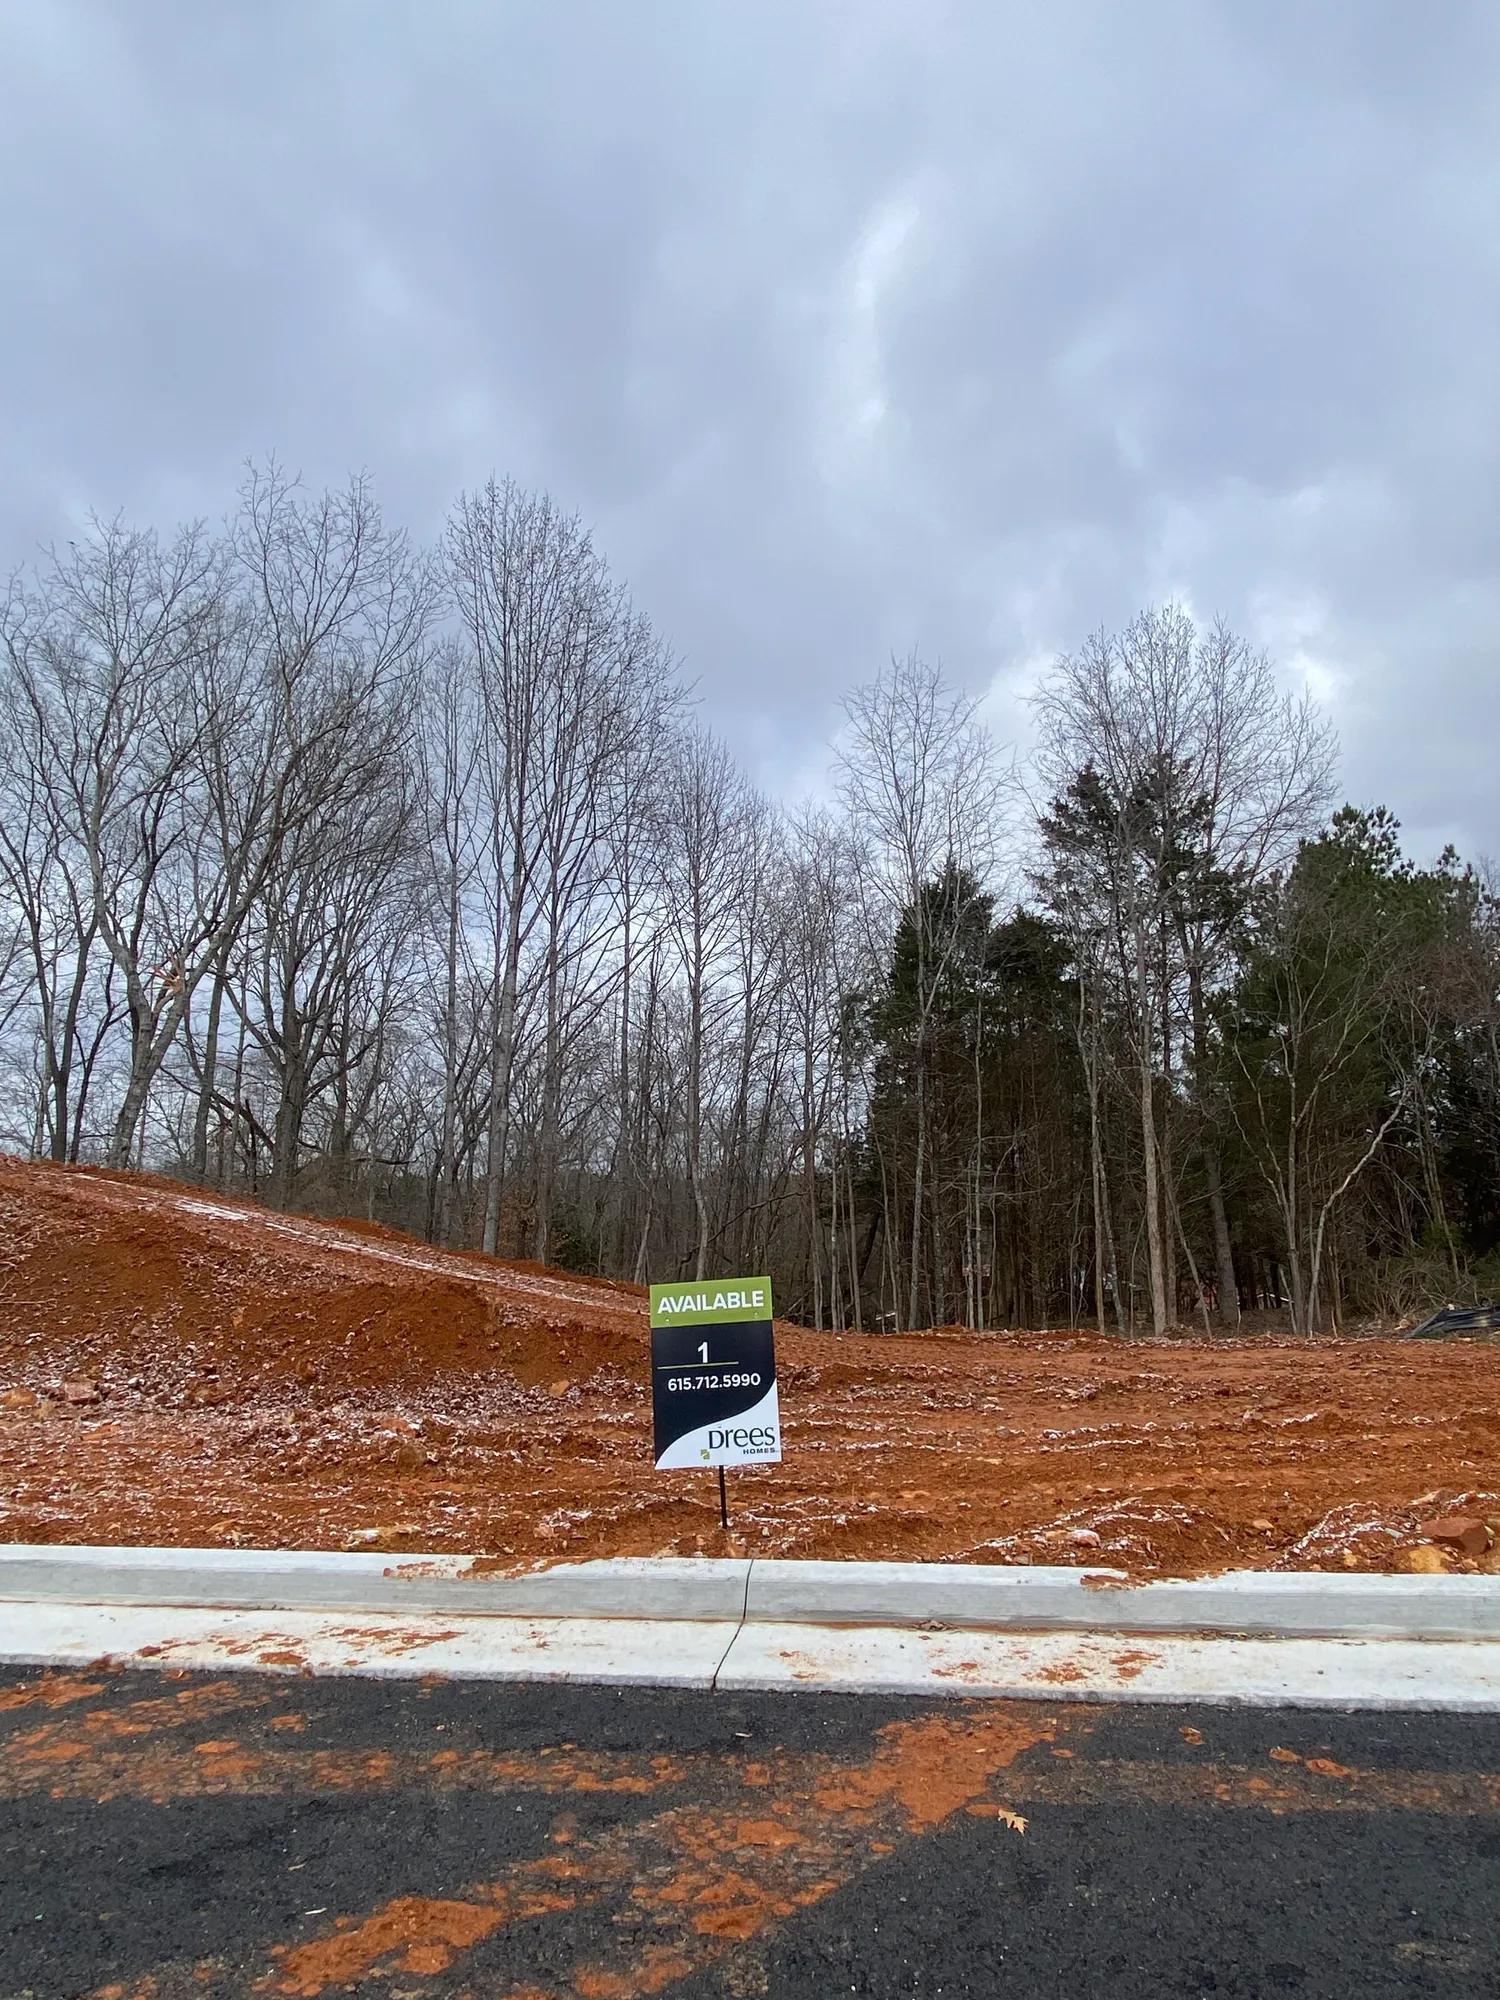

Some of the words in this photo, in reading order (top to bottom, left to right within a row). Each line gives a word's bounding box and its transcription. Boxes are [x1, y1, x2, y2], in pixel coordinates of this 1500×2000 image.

[657, 1290, 764, 1314] AVAILABLE
[697, 1341, 709, 1364] 1
[667, 1373, 761, 1392] 615.712.5990
[708, 1427, 775, 1450] Drees
[742, 1447, 776, 1455] HOMES
